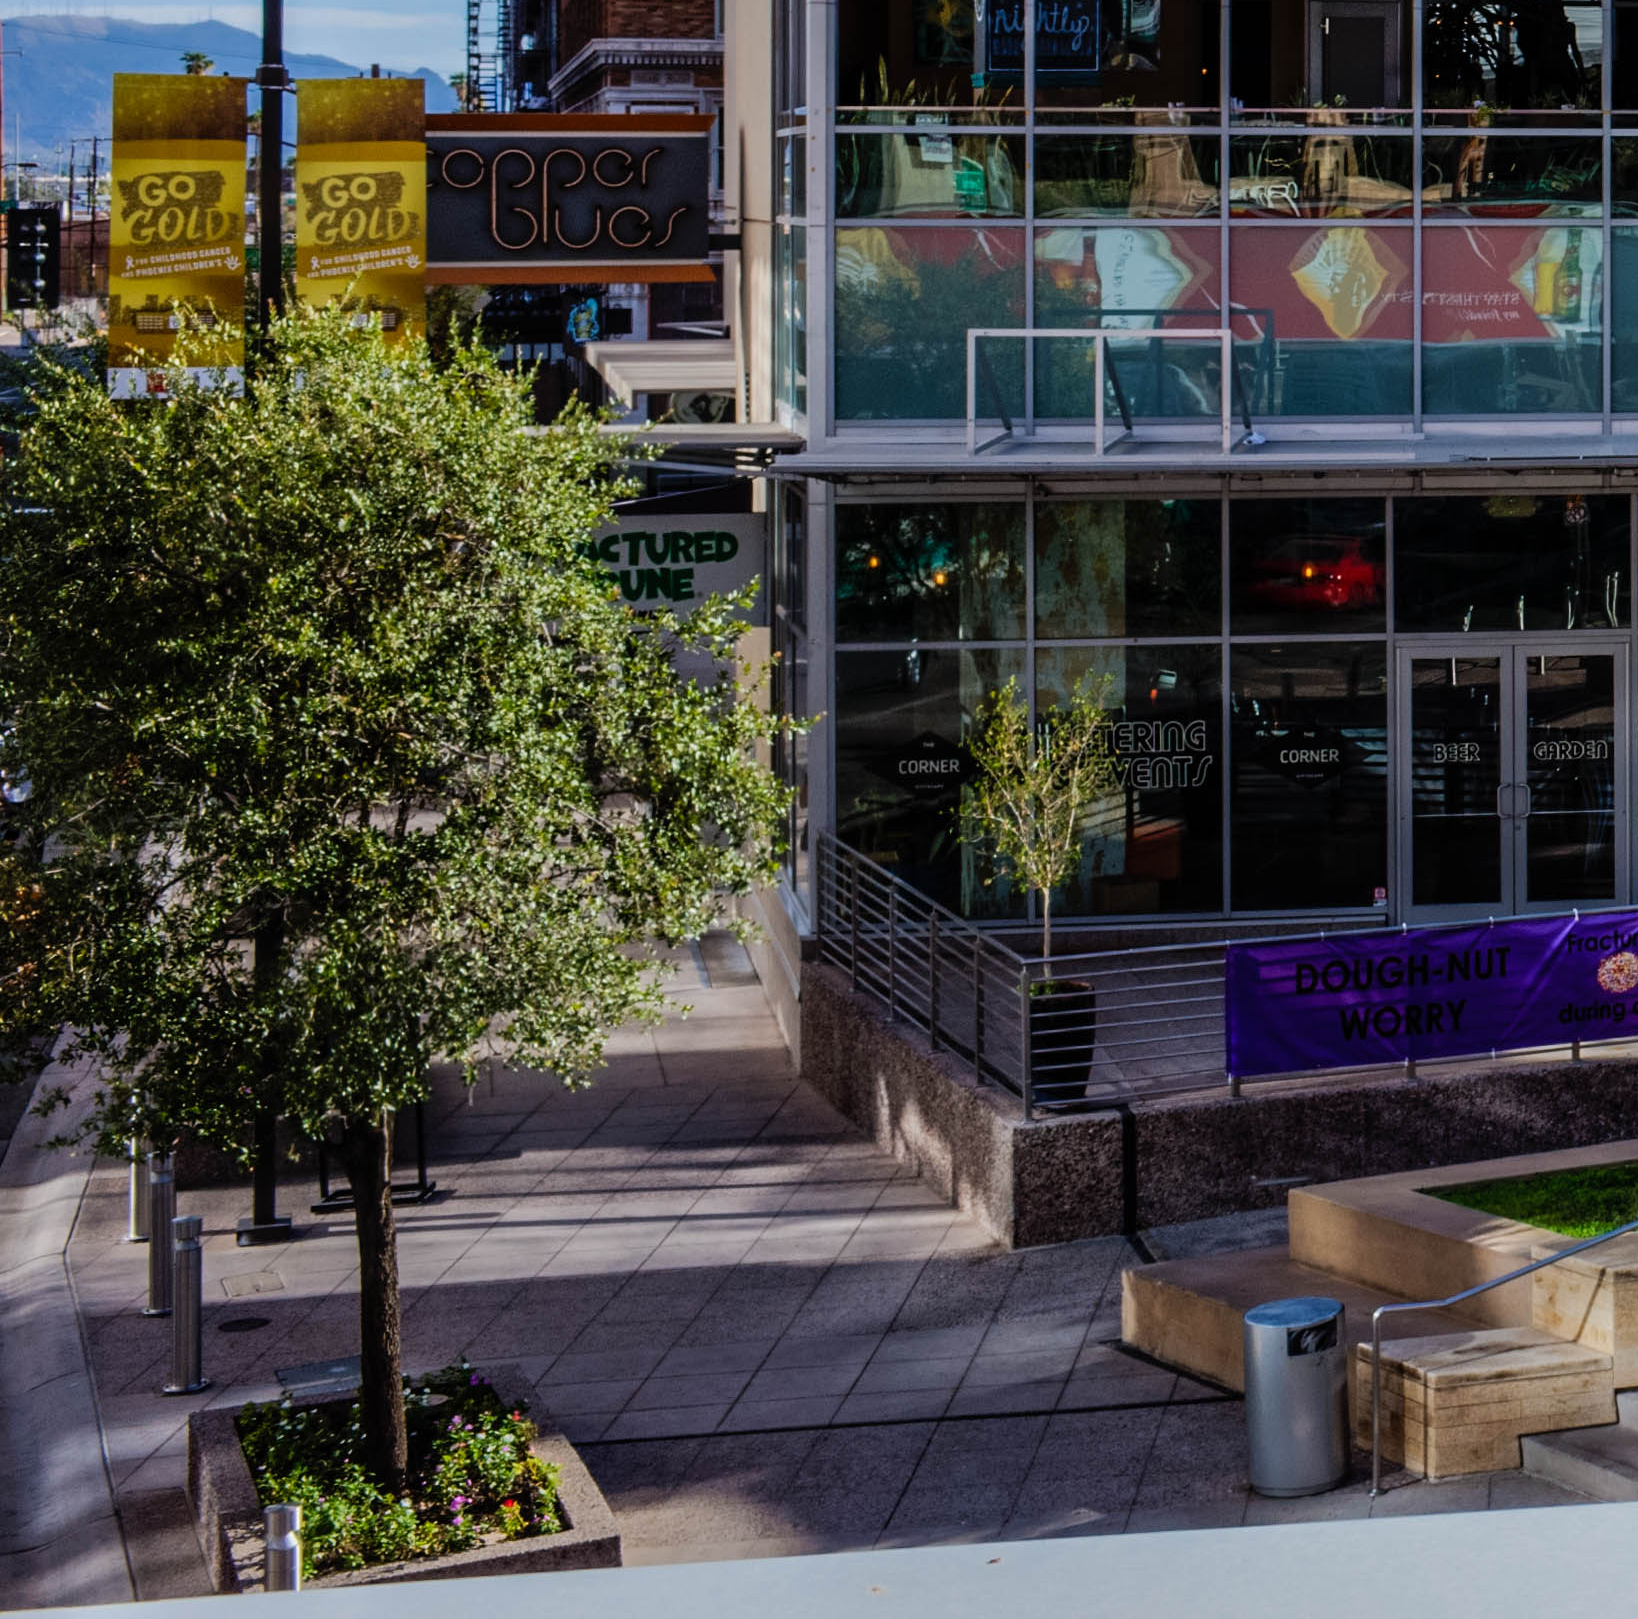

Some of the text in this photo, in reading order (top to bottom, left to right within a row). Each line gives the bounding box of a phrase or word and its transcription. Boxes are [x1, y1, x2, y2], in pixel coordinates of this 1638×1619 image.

[994, 1, 1091, 52] nihtly
[426, 148, 664, 189] opper
[137, 174, 197, 208] GO
[321, 176, 377, 209] GO
[126, 206, 231, 245] GOLD
[310, 206, 410, 246] GOLD
[491, 205, 688, 250] blues
[135, 265, 173, 278] PHOENIX
[173, 258, 222, 273] CHILDREN'S
[149, 250, 198, 265] CHILDHOOD
[199, 245, 231, 258] CANCER
[333, 249, 380, 265] CHILDHOOD
[320, 265, 356, 278] PHOENIX
[1279, 748, 1341, 764] CORNER
[1432, 742, 1481, 763] BEER
[1532, 739, 1609, 761] GARDEN
[899, 758, 961, 775] CORNER
[1295, 946, 1511, 995] DOUGH-NUT
[1340, 999, 1467, 1041] WORRY
[1558, 1002, 1626, 1024] during
